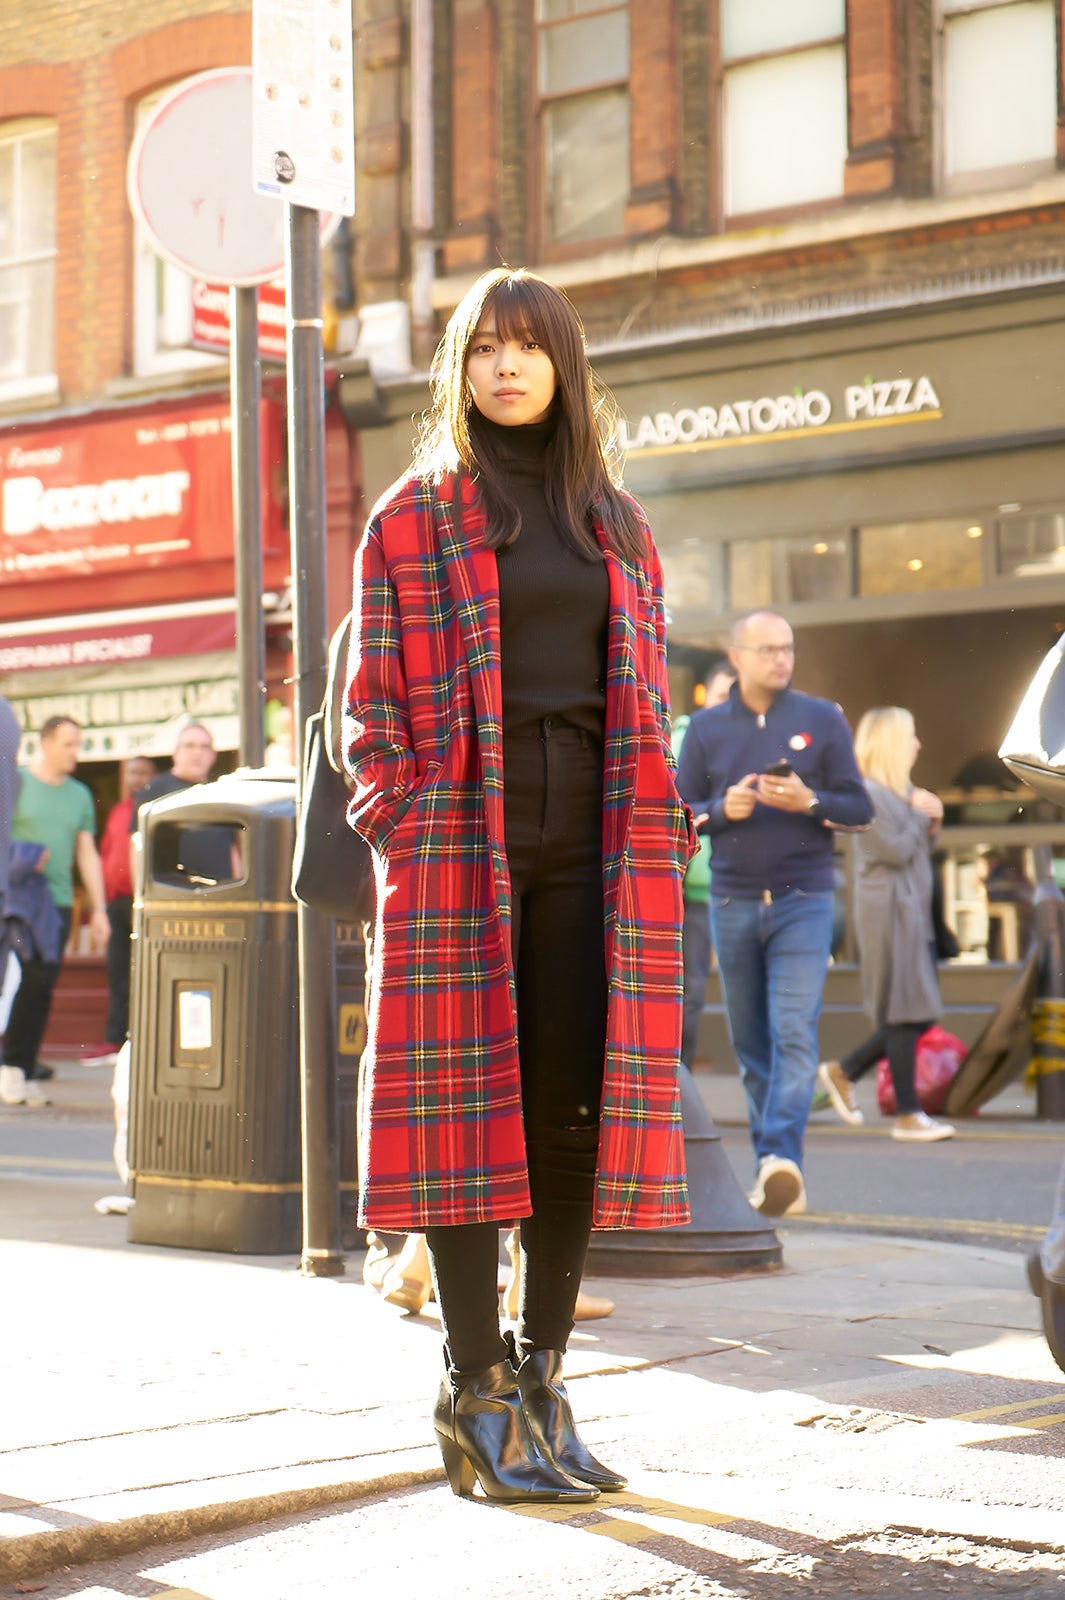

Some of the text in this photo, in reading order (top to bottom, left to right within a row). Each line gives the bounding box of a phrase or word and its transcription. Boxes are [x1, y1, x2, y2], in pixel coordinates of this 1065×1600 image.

[619, 376, 941, 450] LABORATORIO PIZZA
[3, 470, 190, 535] Bazaar
[72, 634, 153, 663] SPECIALIST
[163, 920, 225, 938] LITTER
